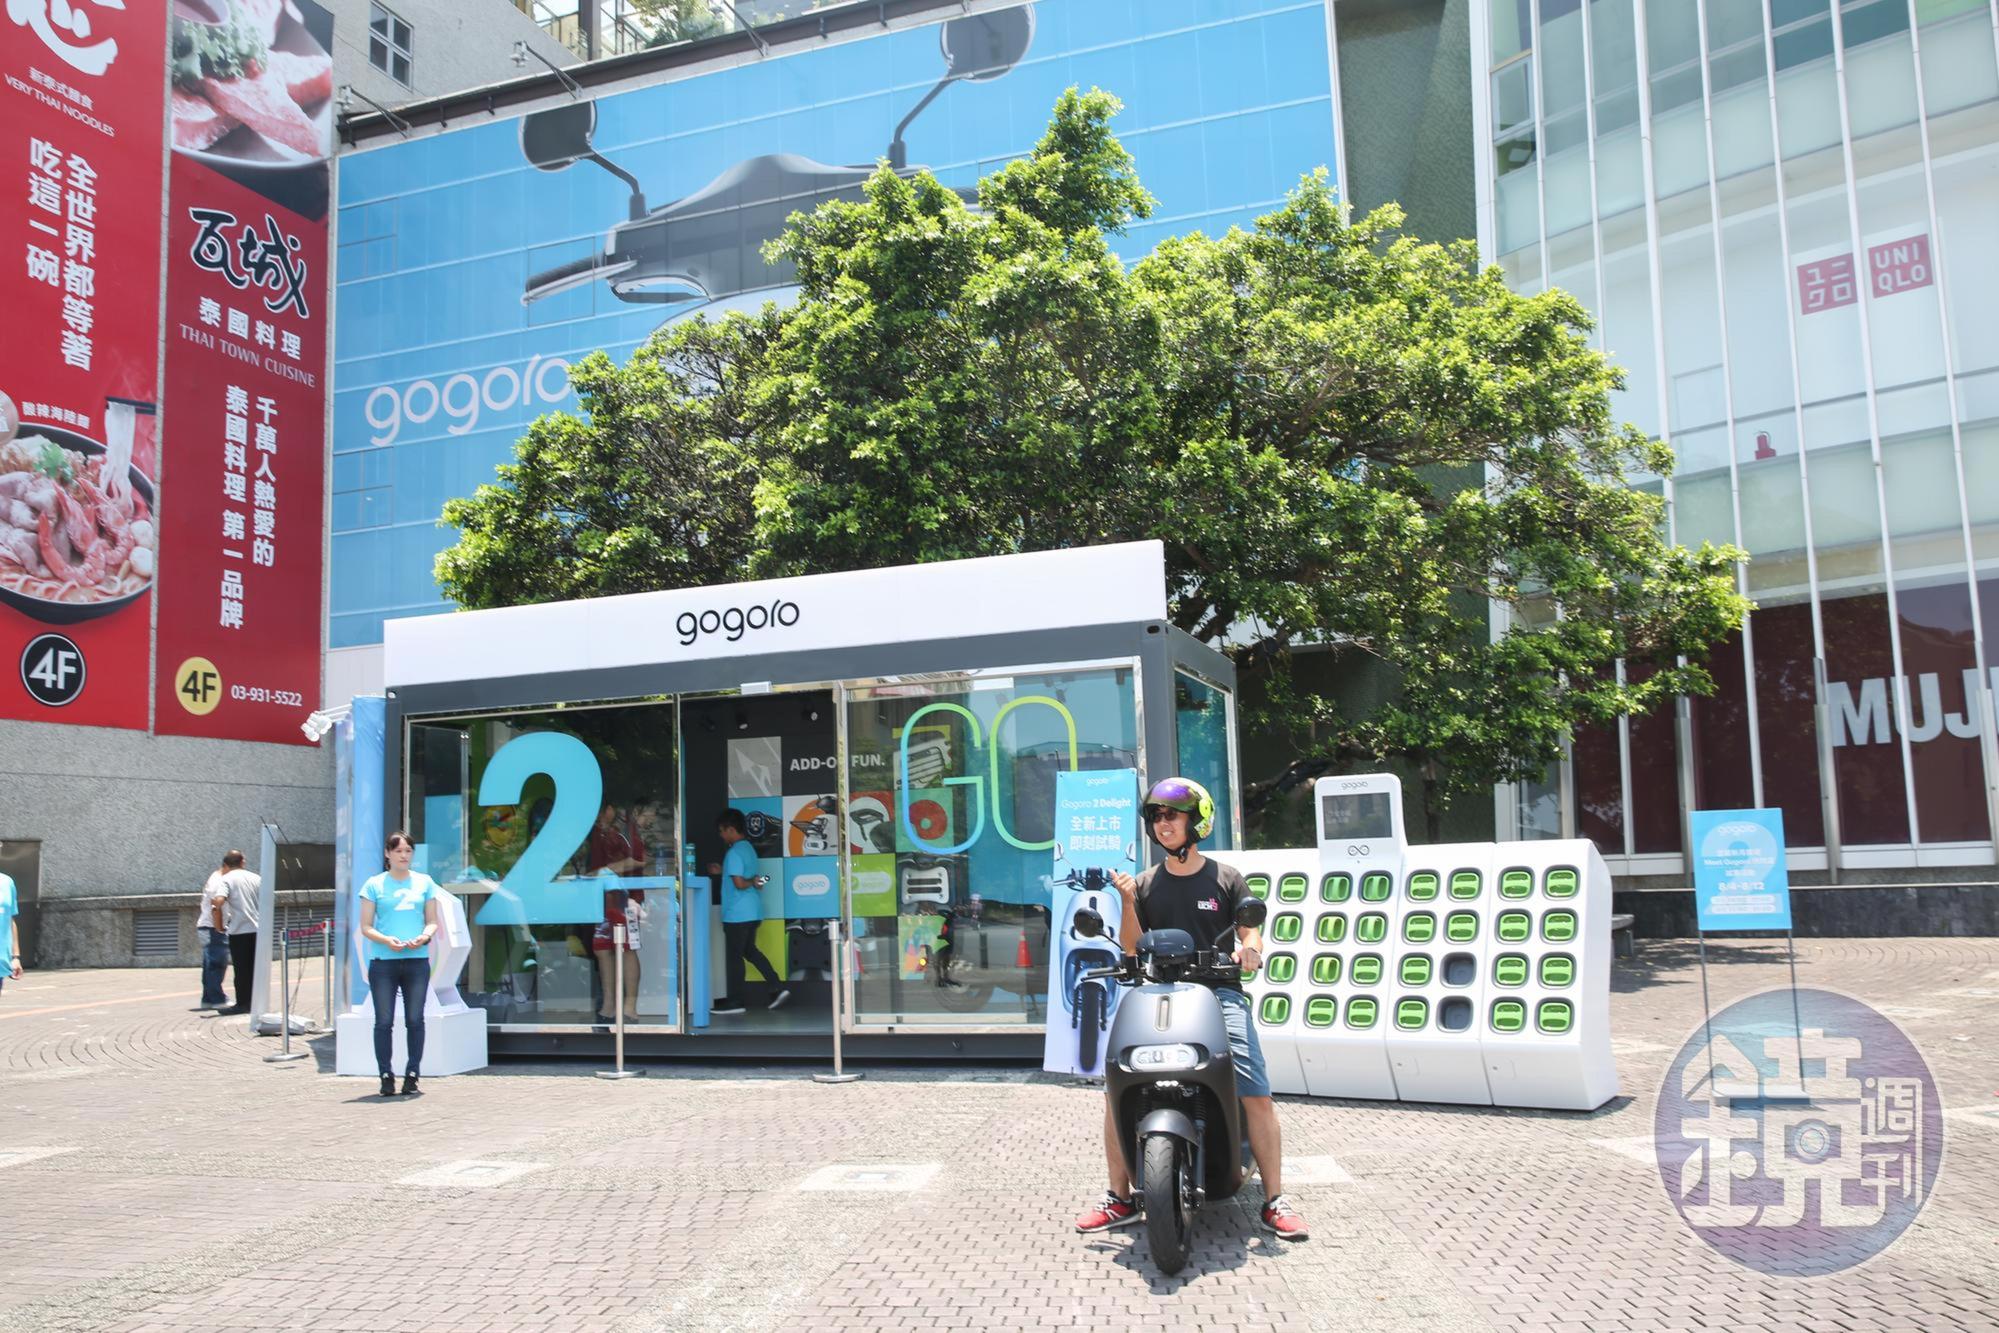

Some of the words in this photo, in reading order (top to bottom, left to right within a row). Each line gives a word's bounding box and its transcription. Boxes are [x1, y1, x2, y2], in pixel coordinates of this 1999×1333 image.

[4, 72, 32, 96] VERY
[32, 87, 61, 111] THAI
[62, 103, 115, 138] NOODLES
[26, 136, 63, 288] 吃這一碗
[60, 152, 98, 372] 全世界都等著
[188, 206, 309, 319] 瓦城
[179, 323, 214, 350] THAI
[219, 338, 260, 367] TOWN
[264, 356, 316, 388] CUISINE
[199, 296, 302, 361] 泰國料理
[364, 353, 574, 447] gogoro
[252, 396, 278, 568] 千萬人熱愛的
[676, 599, 800, 646] gogoro
[28, 647, 77, 690] 4F
[181, 670, 217, 703] 4F
[230, 684, 303, 707] 03-931-5522
[790, 756, 838, 771] ADD-O
[851, 754, 886, 768] FUN.
[901, 696, 1079, 855] GO
[474, 731, 604, 925] 2
[1070, 815, 1121, 831] 全新上市
[393, 887, 416, 911] 2
